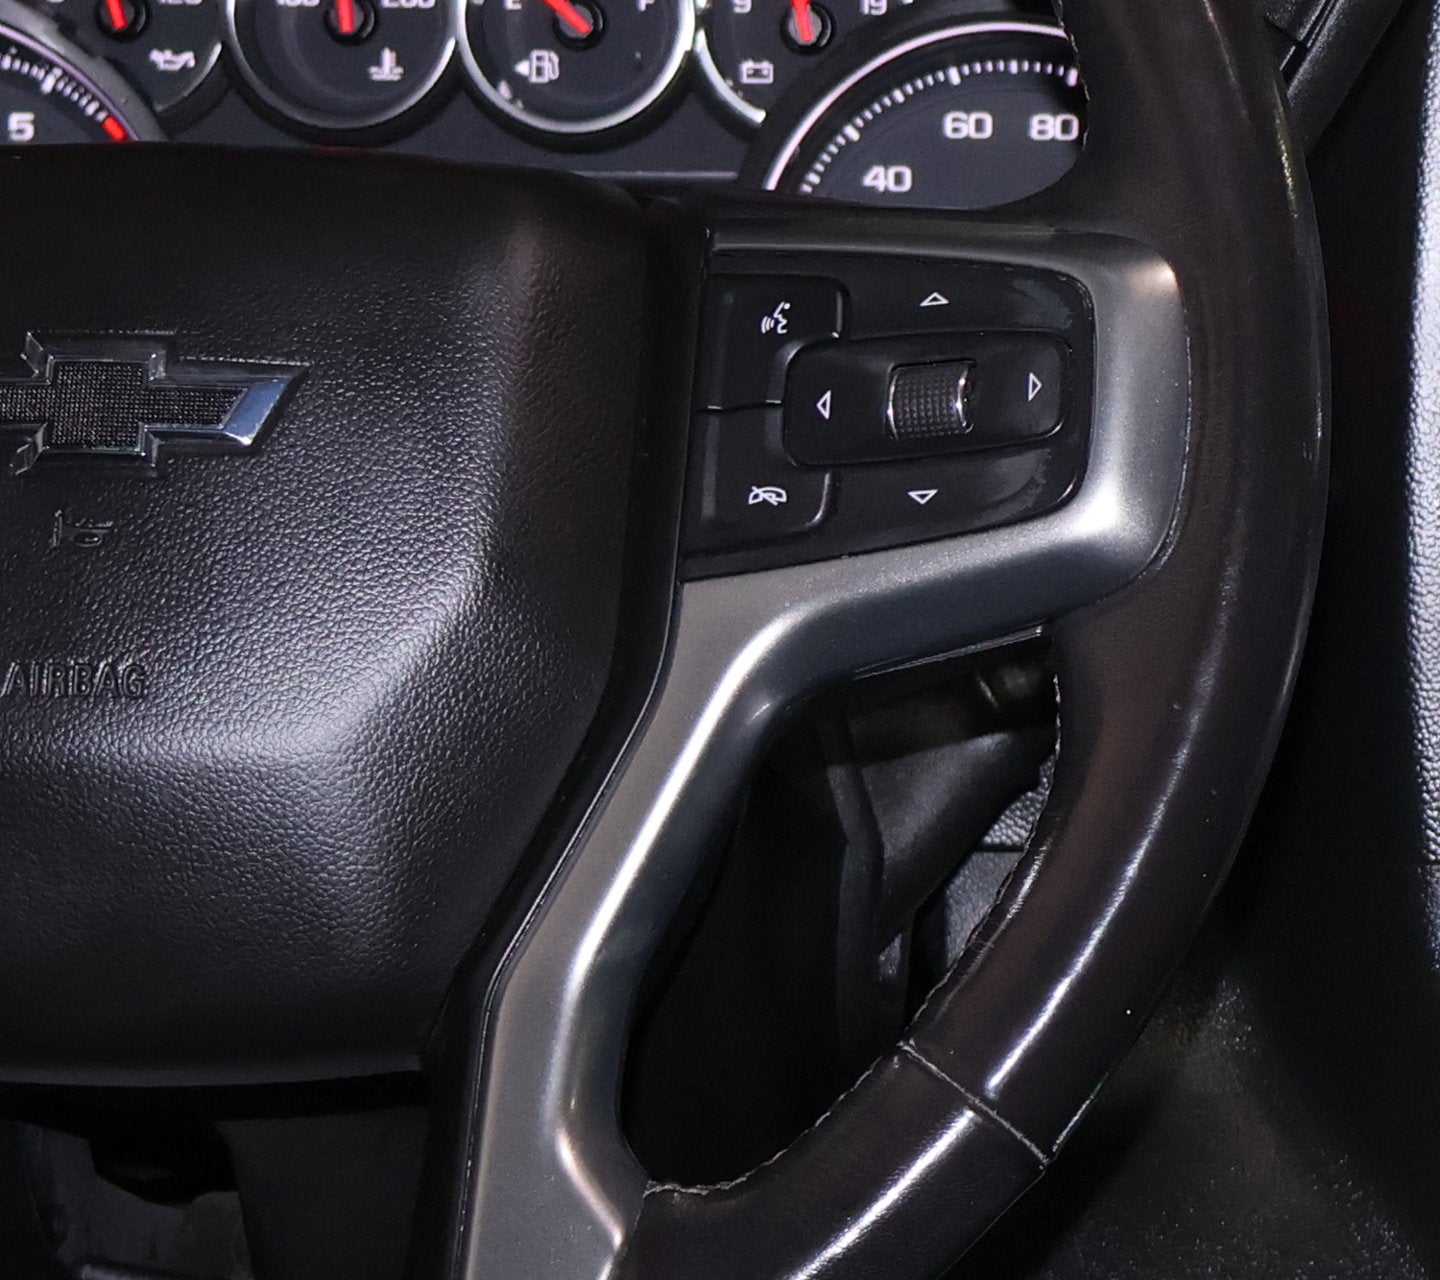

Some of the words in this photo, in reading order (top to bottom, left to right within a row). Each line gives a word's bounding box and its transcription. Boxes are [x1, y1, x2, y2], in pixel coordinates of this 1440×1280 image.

[6, 111, 35, 142] 5
[942, 111, 994, 140] 60
[1028, 113, 1081, 141] 80
[861, 164, 913, 193] 40
[0, 659, 146, 699] AIRBAG
